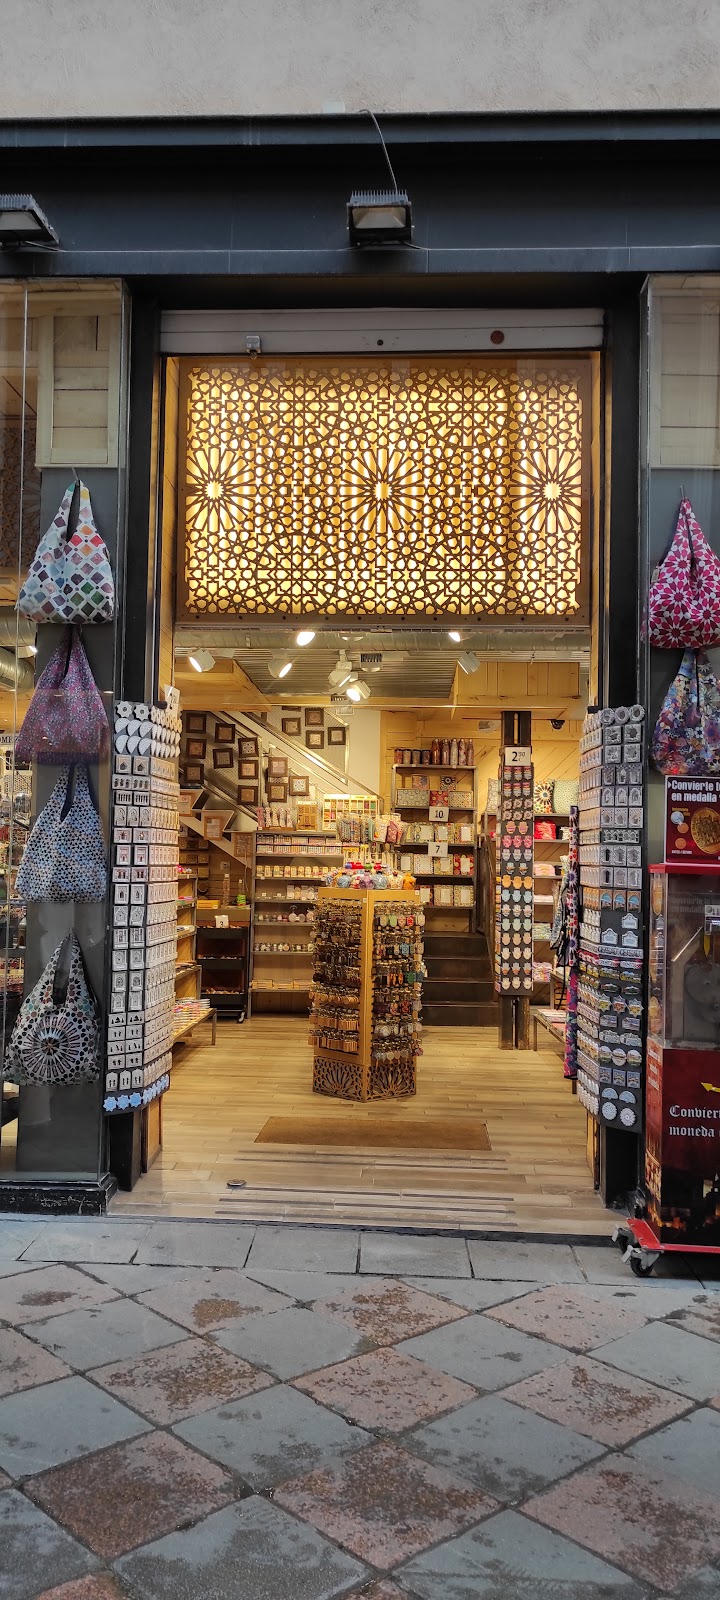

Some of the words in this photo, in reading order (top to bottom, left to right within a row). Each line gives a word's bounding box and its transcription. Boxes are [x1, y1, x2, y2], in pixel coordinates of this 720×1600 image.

[671, 780, 714, 791] Convierte
[671, 792, 682, 802] en
[683, 791, 718, 803] medalla
[435, 810, 444, 819] 10
[435, 845, 441, 854] 7
[669, 1125, 715, 1137] moneda
